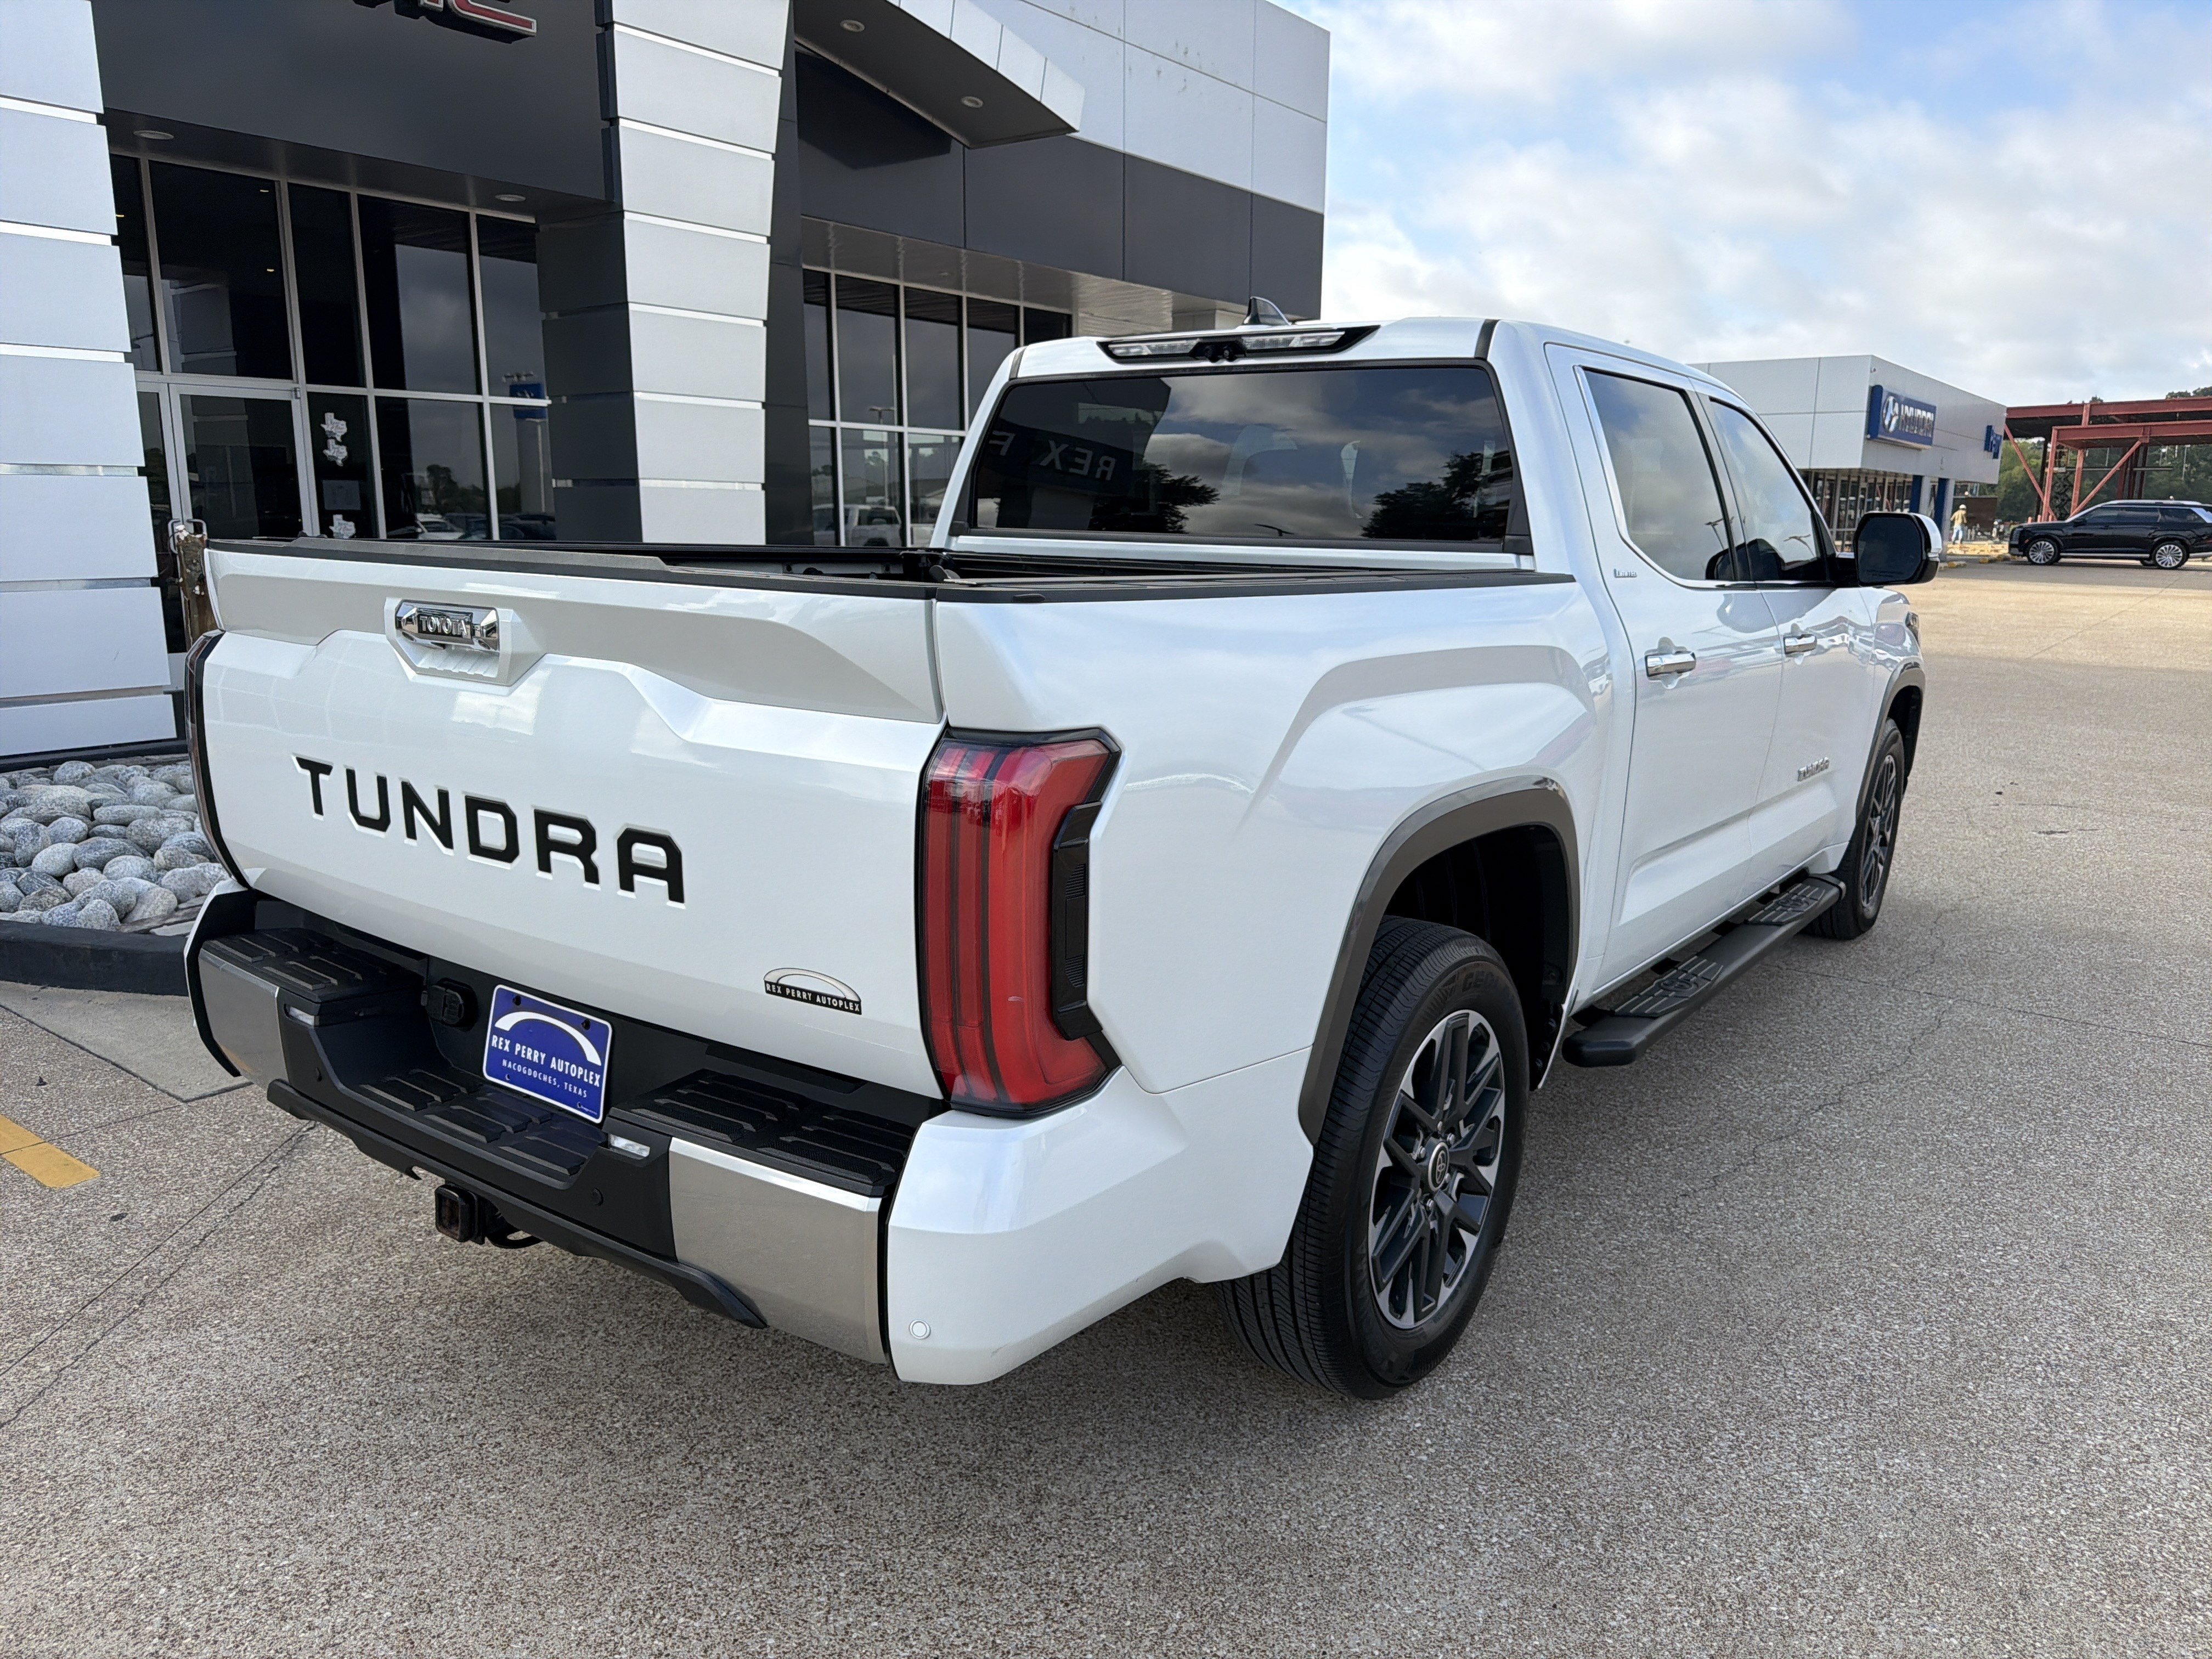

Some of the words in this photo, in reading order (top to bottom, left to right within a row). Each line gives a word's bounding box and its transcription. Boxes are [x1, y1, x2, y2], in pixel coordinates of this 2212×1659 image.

[1899, 404, 1934, 437] HYUNDAI
[419, 615, 469, 636] TOYOTA
[294, 754, 685, 907] TUNDRA
[766, 983, 782, 994] REX
[786, 988, 812, 1001] PERRY
[816, 995, 860, 1012] AUTOPLEX
[492, 1035, 510, 1052] REX
[515, 1043, 546, 1065] PERRY
[550, 1057, 601, 1087] AUTOPLEX
[502, 1059, 560, 1087] NACOGDOCHES,
[563, 1082, 587, 1098] TEXAS
